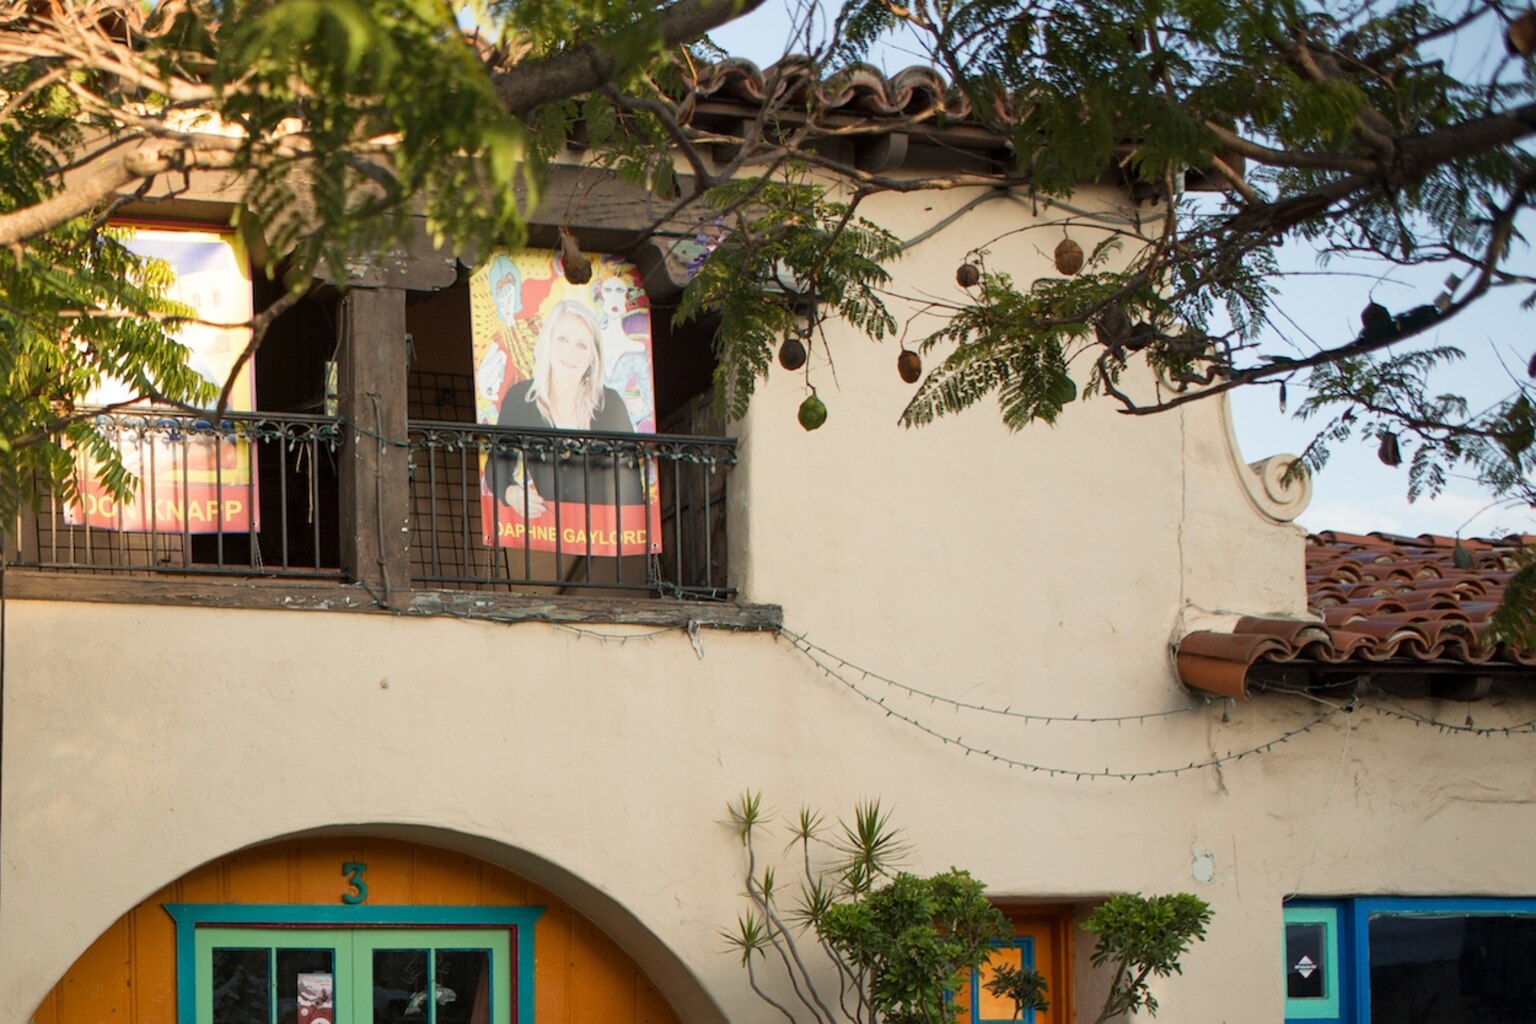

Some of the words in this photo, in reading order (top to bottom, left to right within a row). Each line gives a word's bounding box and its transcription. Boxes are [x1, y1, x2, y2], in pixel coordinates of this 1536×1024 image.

[146, 498, 243, 522] KNAPP
[563, 528, 647, 545] GAYLORD
[342, 863, 368, 904] 3
